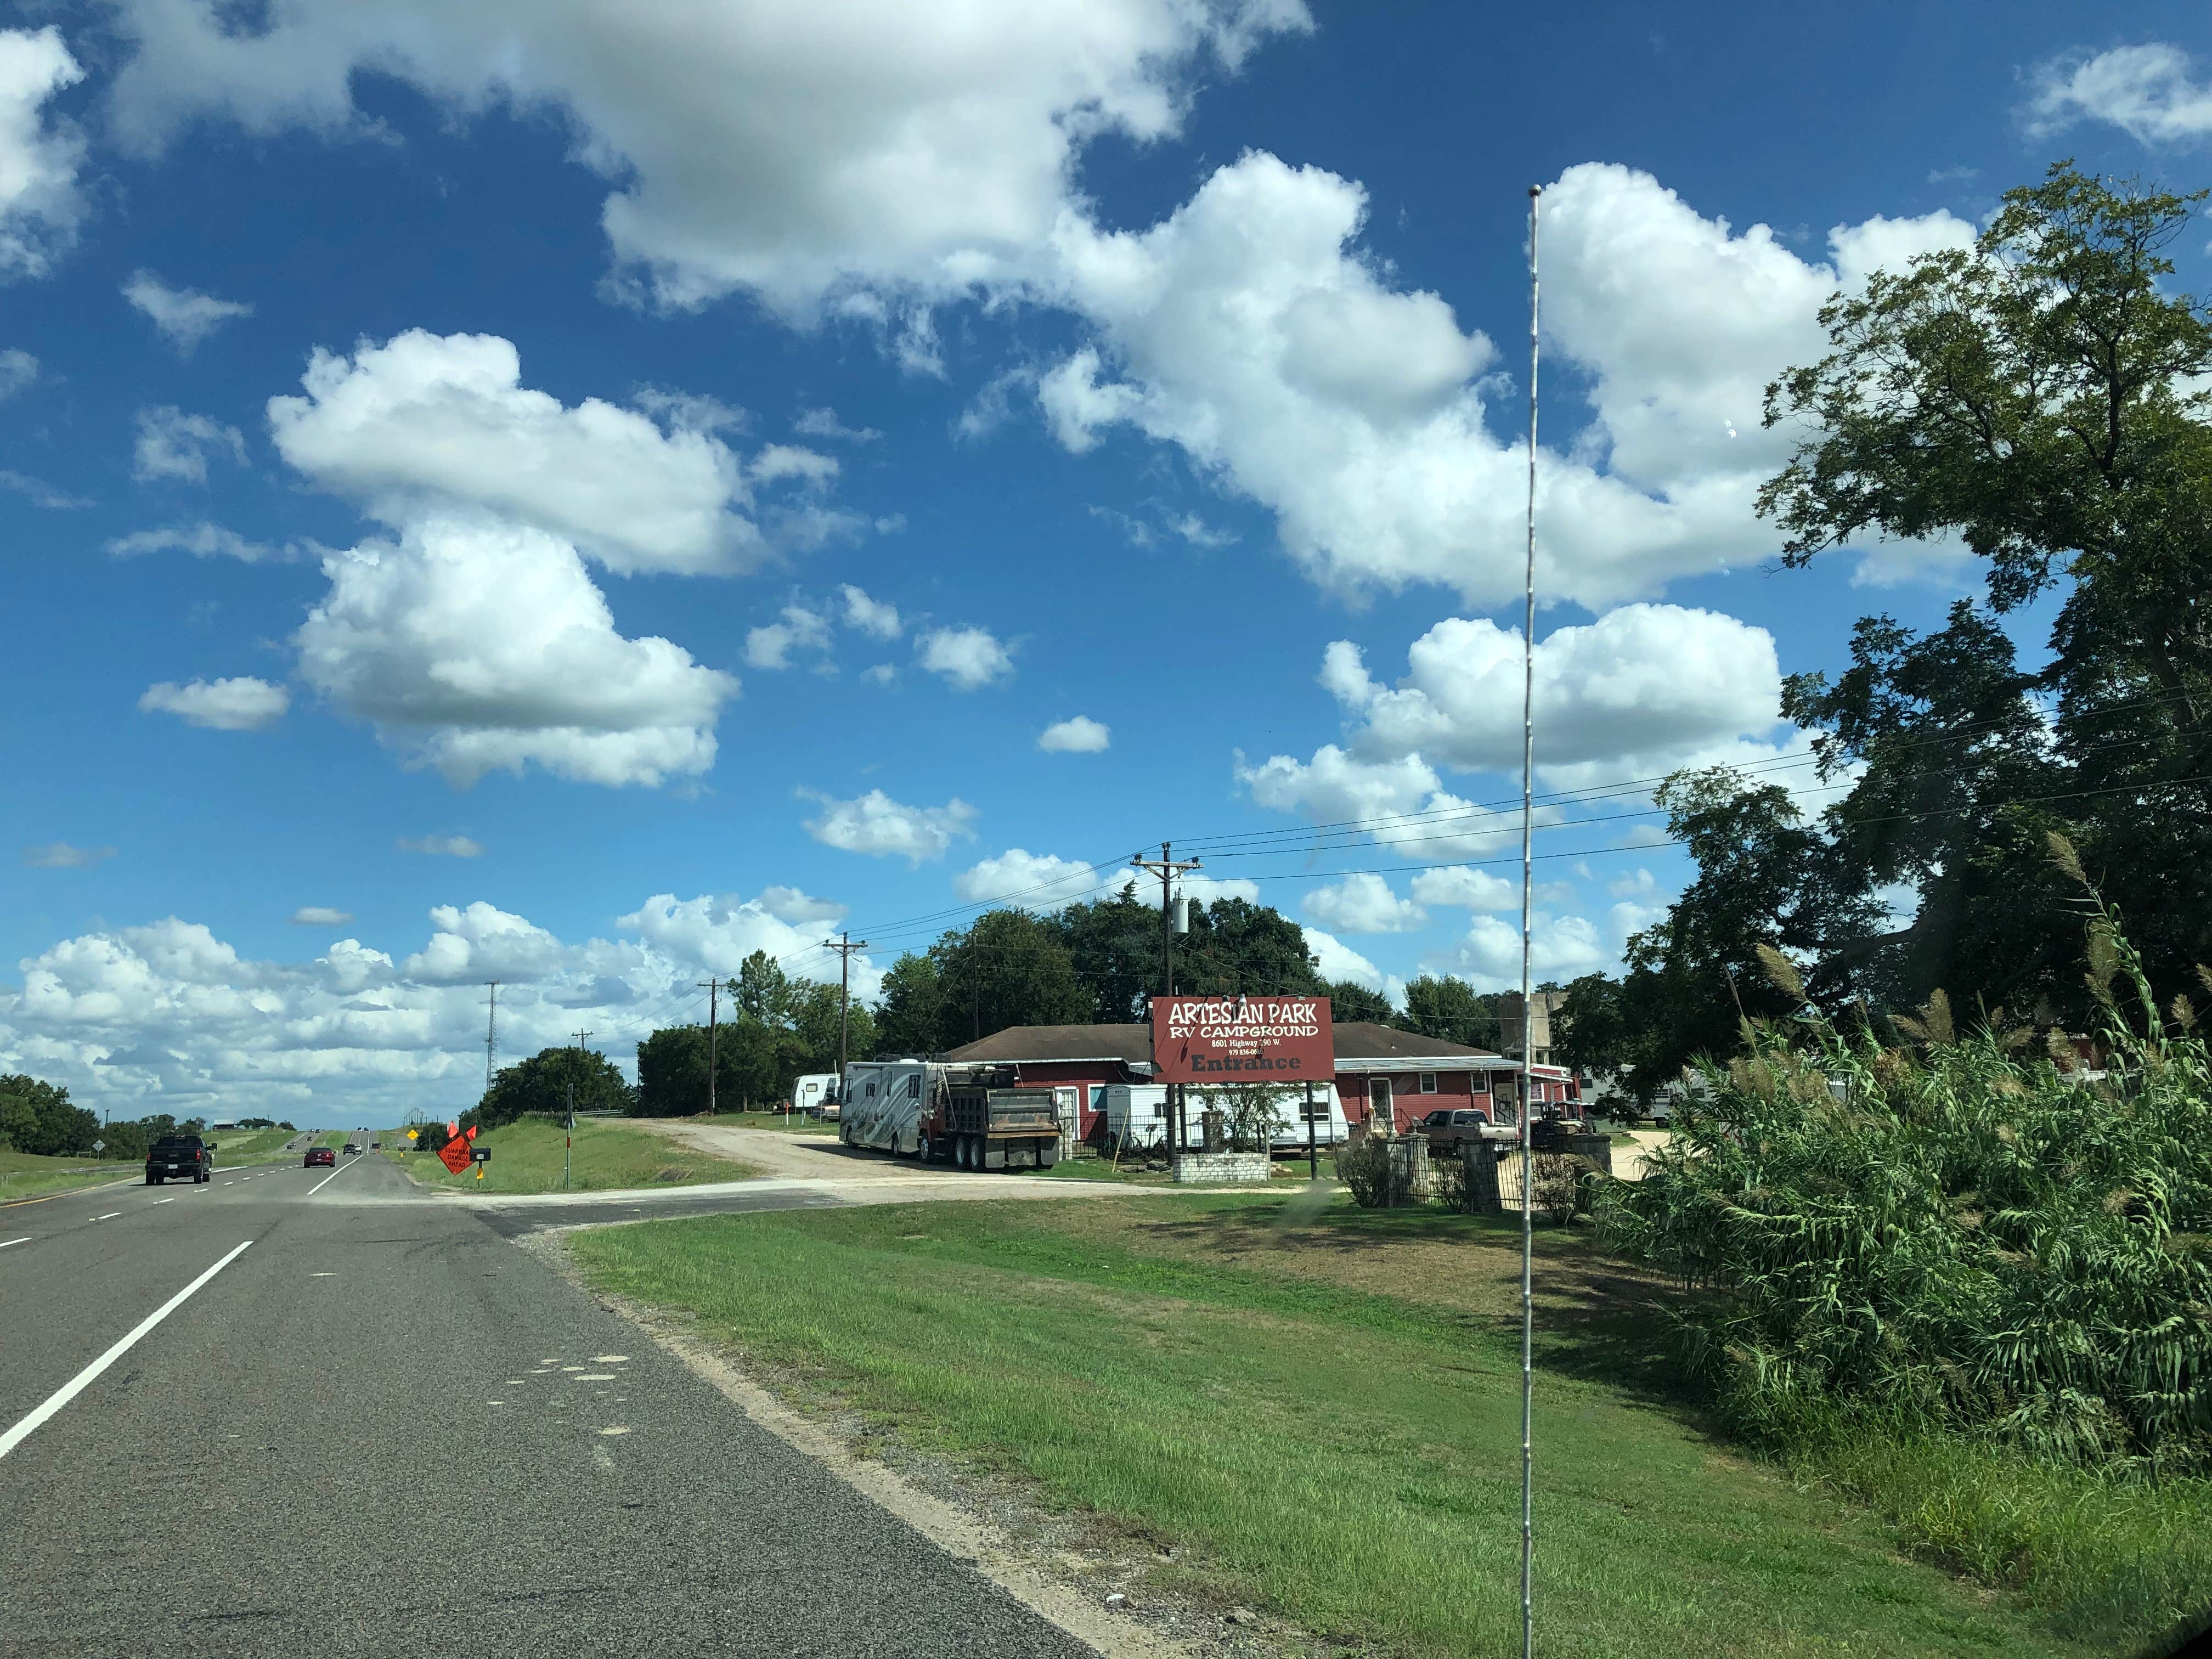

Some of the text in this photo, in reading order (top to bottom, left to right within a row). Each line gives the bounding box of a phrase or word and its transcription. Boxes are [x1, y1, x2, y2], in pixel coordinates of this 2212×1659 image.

[1169, 1002, 1317, 1024] ARTESIAN PARK
[1170, 1025, 1319, 1039] RV CAMPGROUND
[1229, 1040, 1258, 1048] Highway
[1191, 1054, 1301, 1072] Entrance
